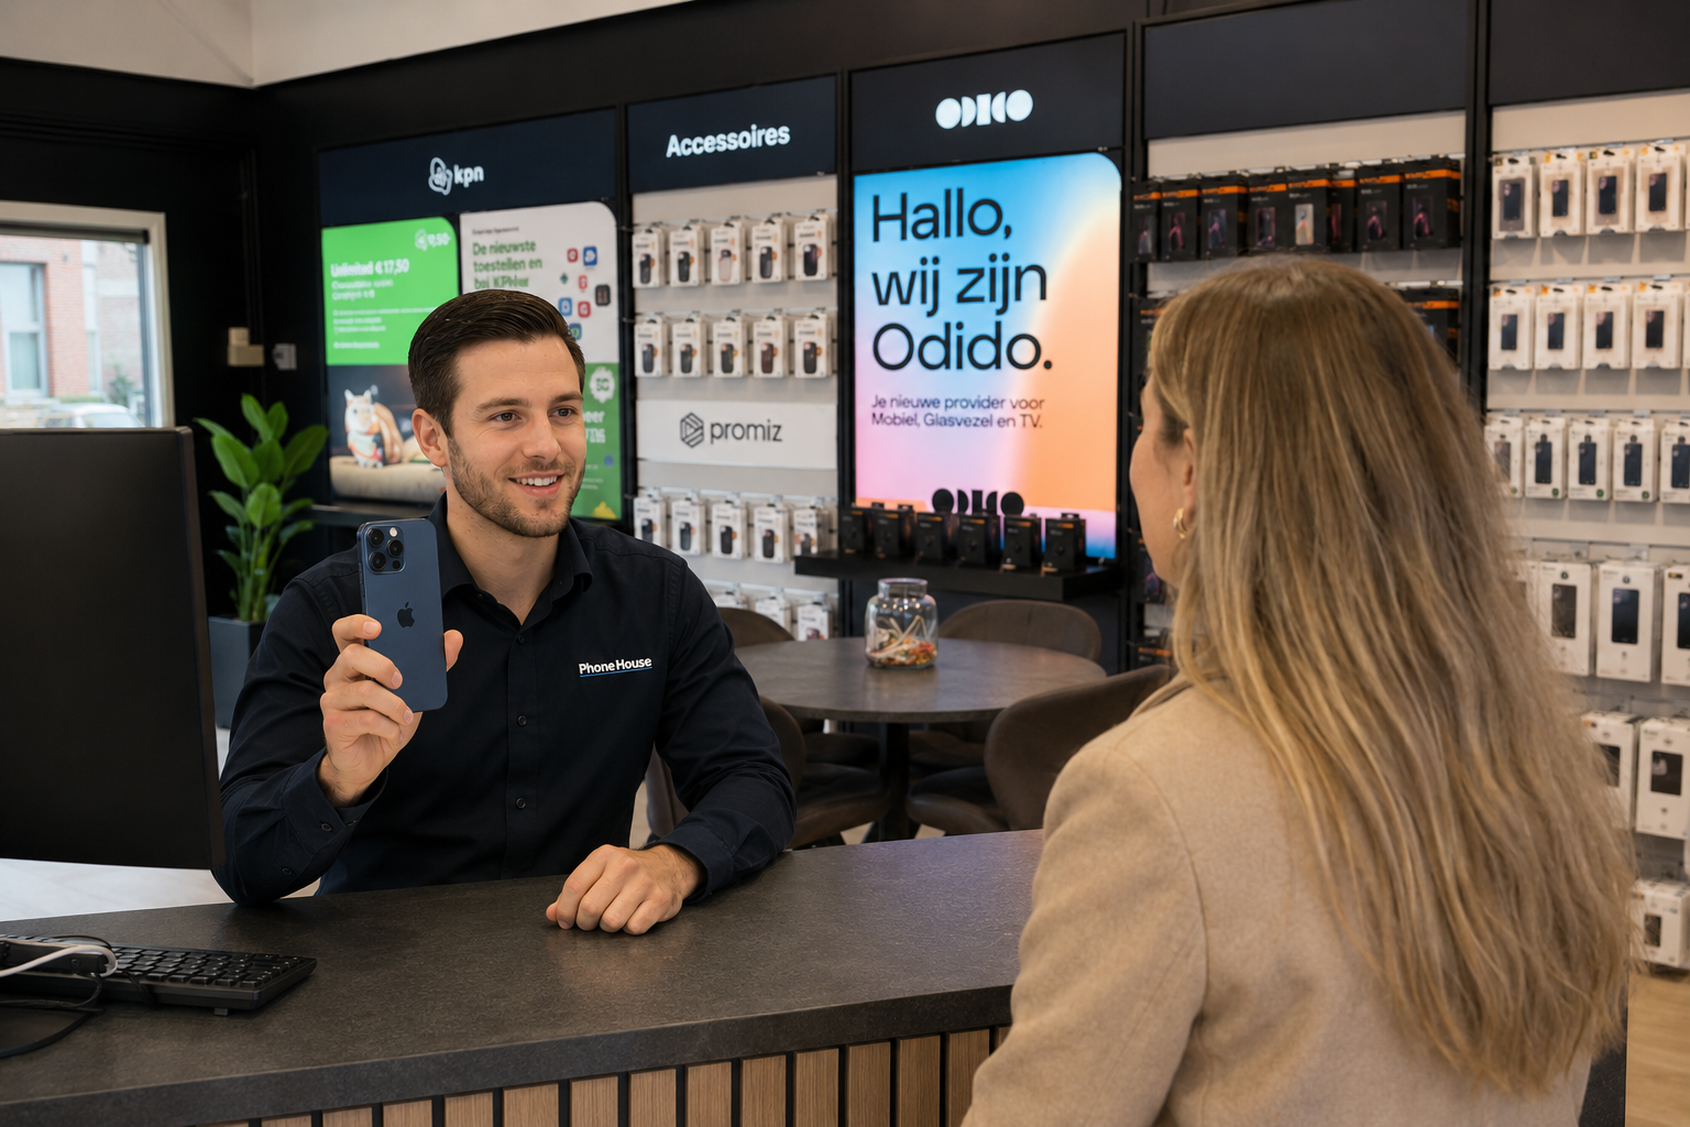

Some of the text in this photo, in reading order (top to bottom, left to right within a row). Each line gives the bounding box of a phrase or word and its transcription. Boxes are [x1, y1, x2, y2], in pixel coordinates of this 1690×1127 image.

[666, 123, 791, 158] Accessoires
[453, 164, 485, 188] kpn
[872, 187, 1012, 243] Hallo,
[472, 240, 536, 256] De nieuwste
[528, 258, 543, 269] en
[871, 252, 1048, 318] wij zijn
[872, 320, 1053, 371] Odido.
[871, 394, 1045, 411] Je nieuwe provider voor
[710, 418, 783, 445] promiz
[871, 412, 1043, 428] Mobiel, Glasvezel en TV.
[578, 657, 652, 675] Phone House
